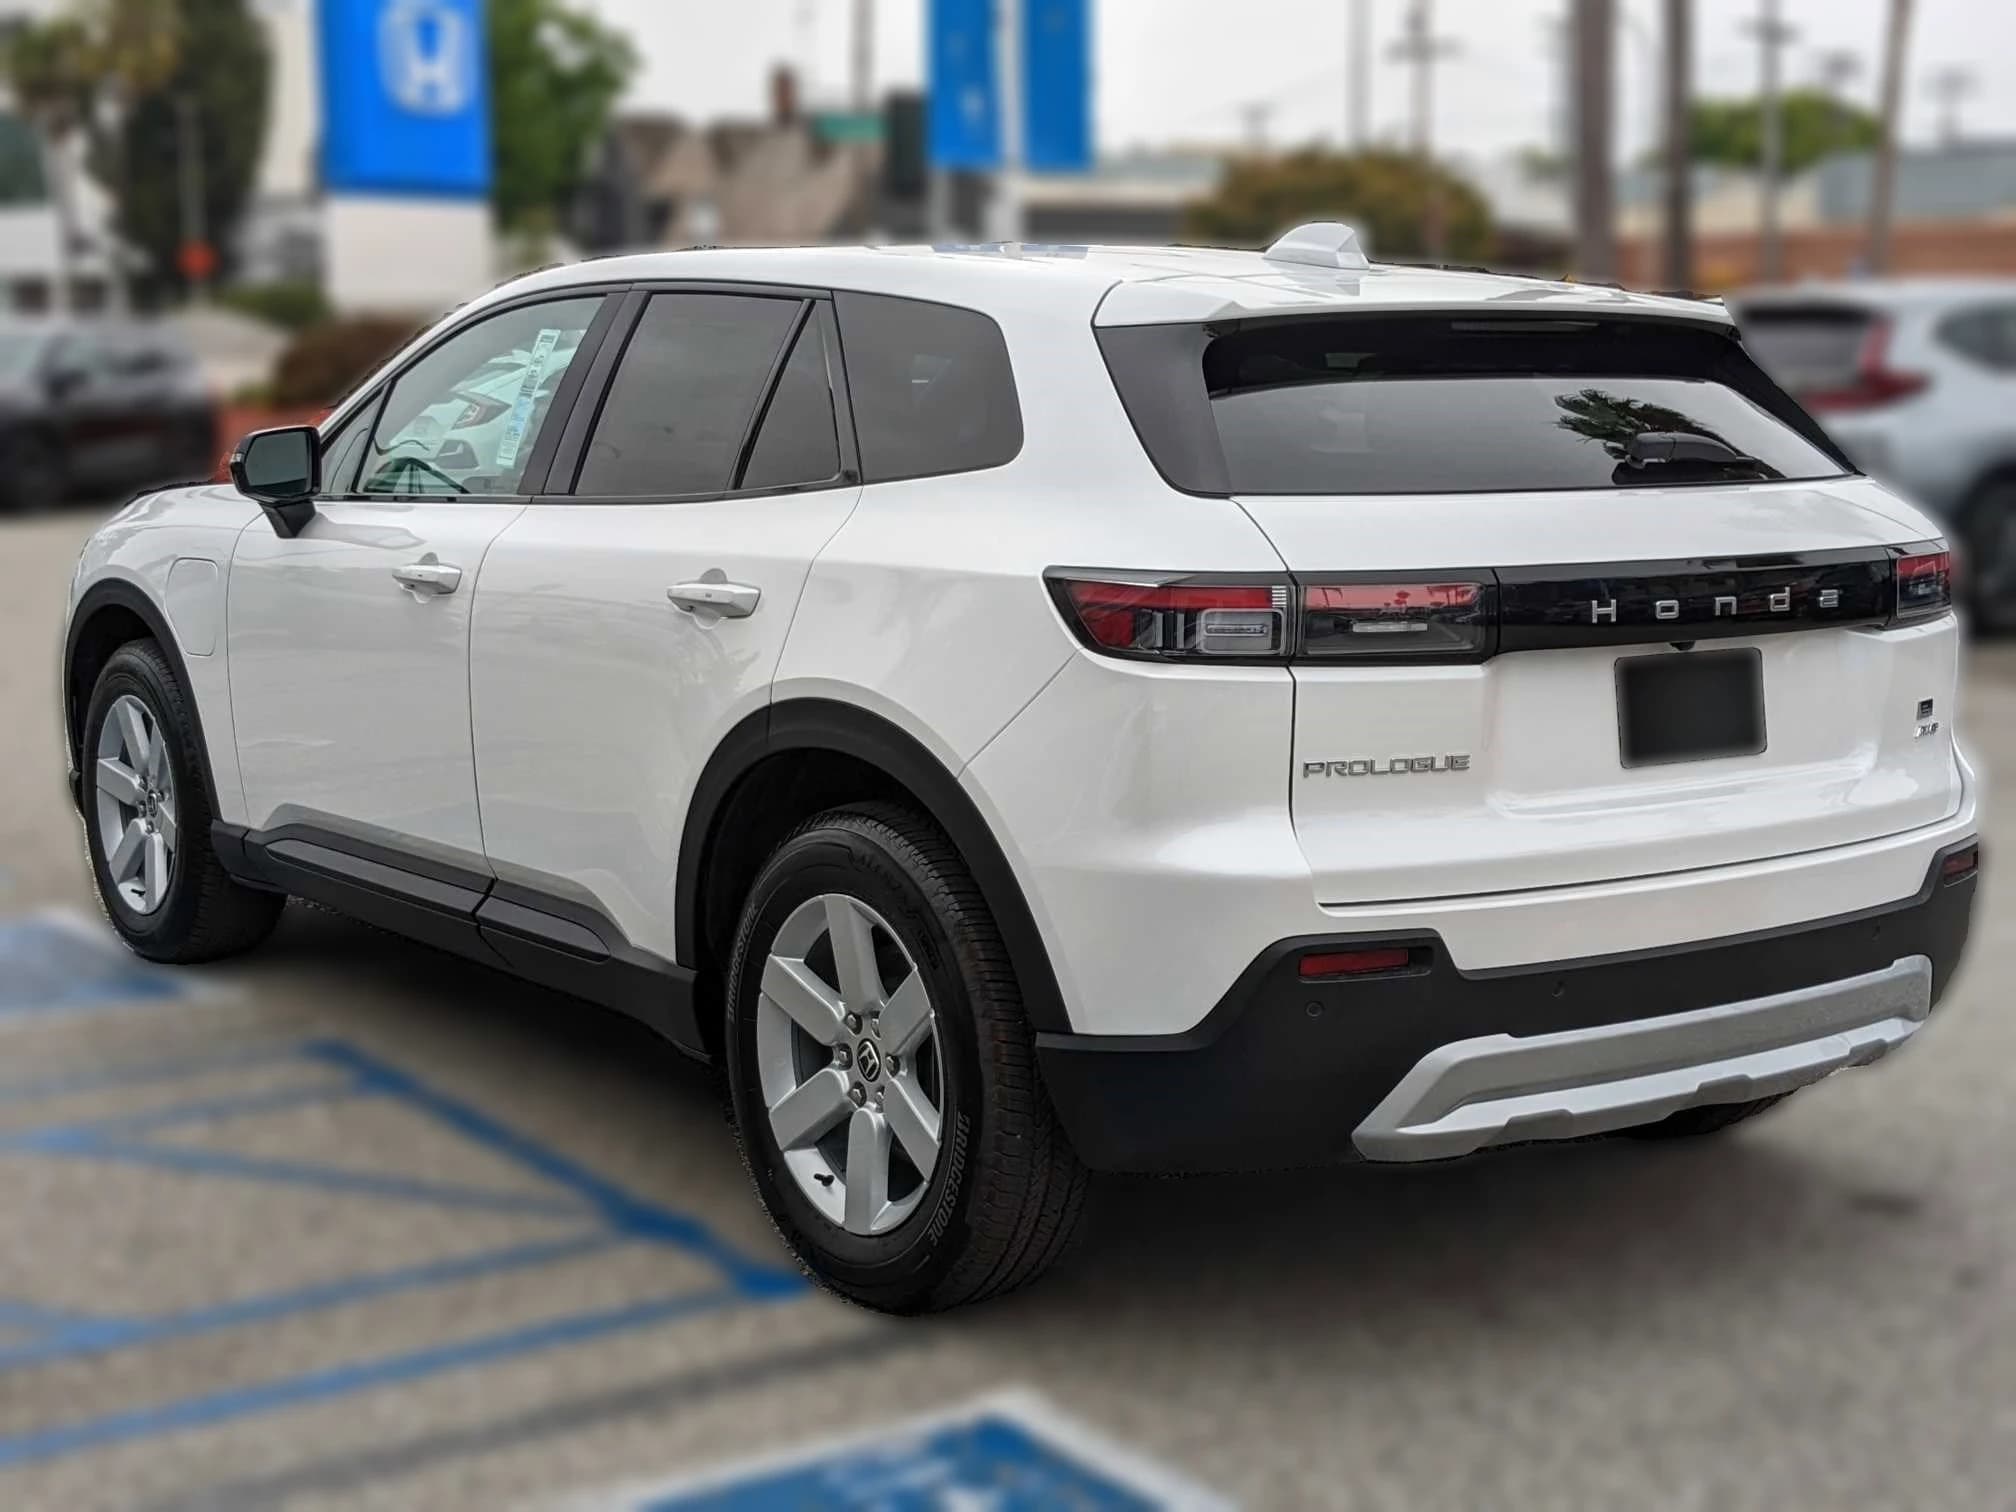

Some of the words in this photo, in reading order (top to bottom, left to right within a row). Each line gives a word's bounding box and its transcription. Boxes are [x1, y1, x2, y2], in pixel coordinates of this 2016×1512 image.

[1591, 586, 1840, 624] Honda
[1303, 755, 1470, 778] PROLOGUE
[928, 1111, 971, 1246] BRIDGESTONE
